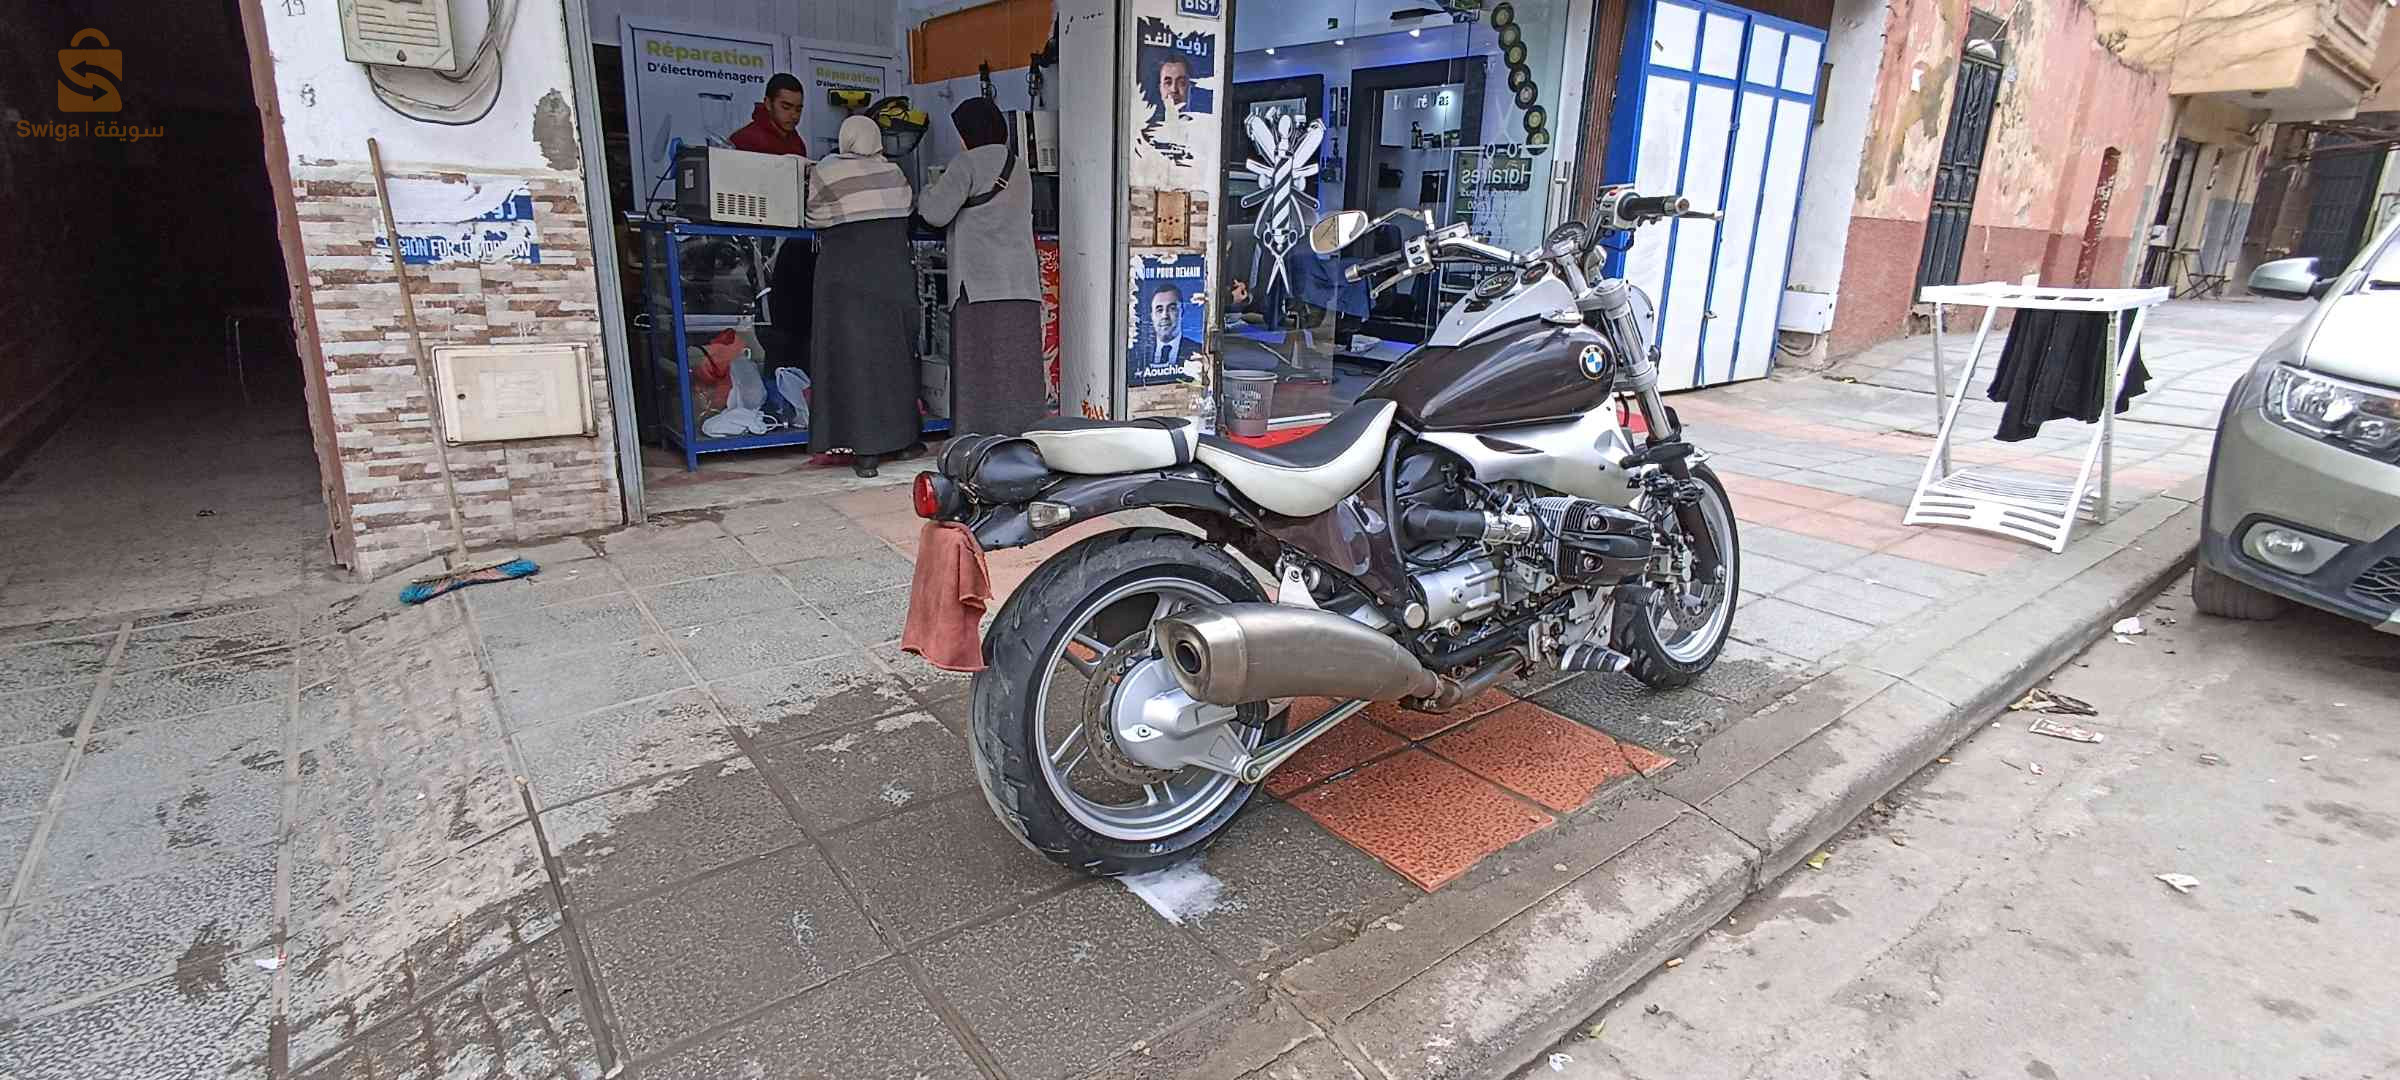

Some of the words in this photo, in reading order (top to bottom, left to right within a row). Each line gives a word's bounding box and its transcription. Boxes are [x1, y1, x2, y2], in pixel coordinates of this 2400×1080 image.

[1143, 32, 1172, 47] للغد
[646, 39, 766, 68] Réparation
[647, 62, 765, 84] D'électroménagers
[431, 239, 455, 257] FOR
